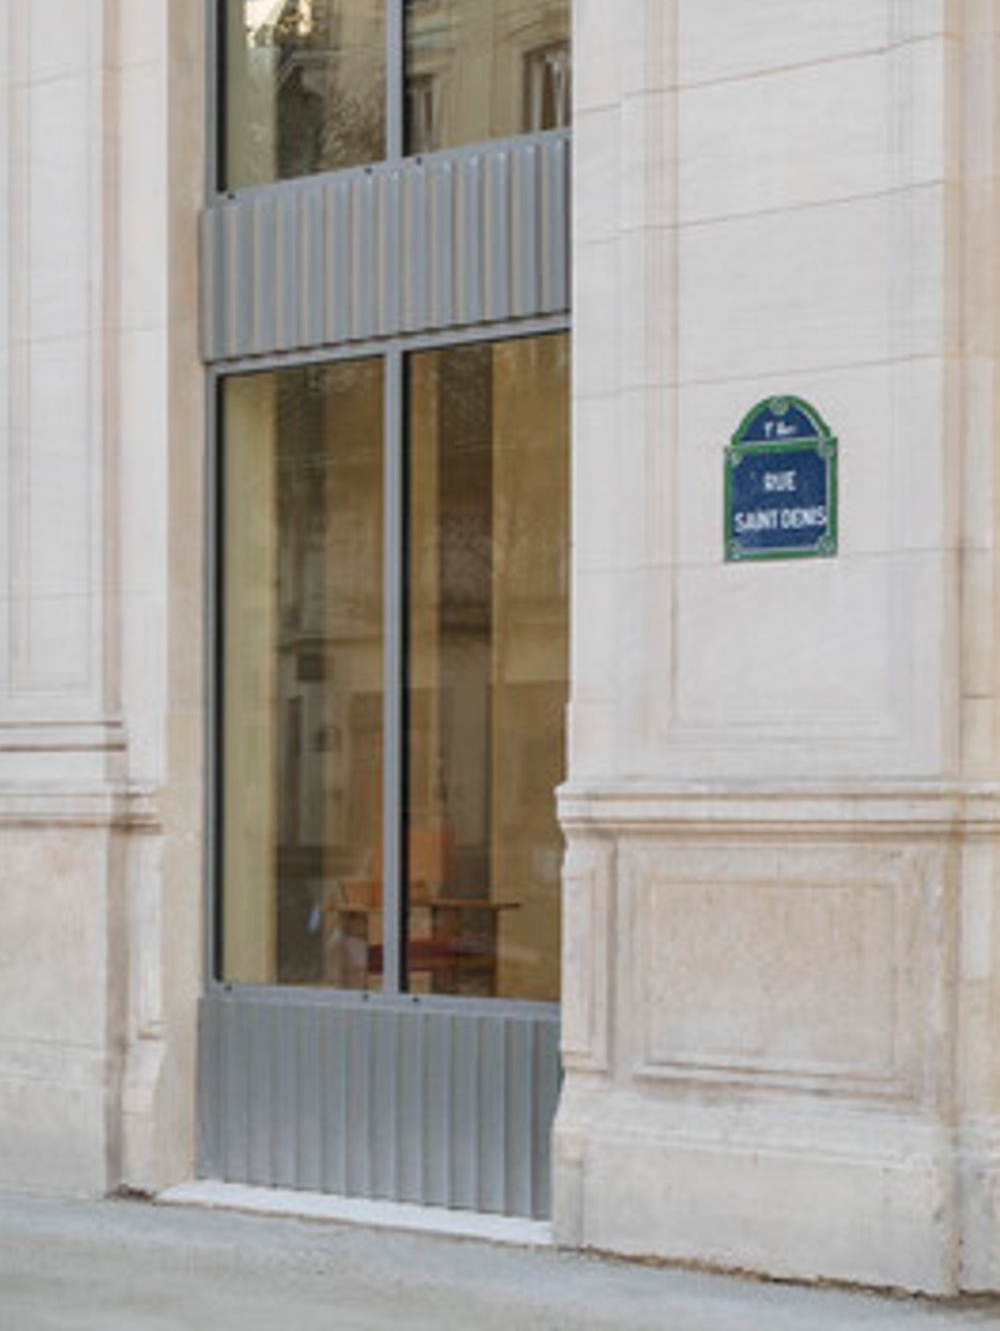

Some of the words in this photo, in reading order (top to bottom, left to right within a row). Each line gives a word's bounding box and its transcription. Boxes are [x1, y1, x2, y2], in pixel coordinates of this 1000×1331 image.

[764, 470, 797, 492] RUE
[733, 509, 778, 533] SAINT
[780, 505, 826, 529] DENIS
